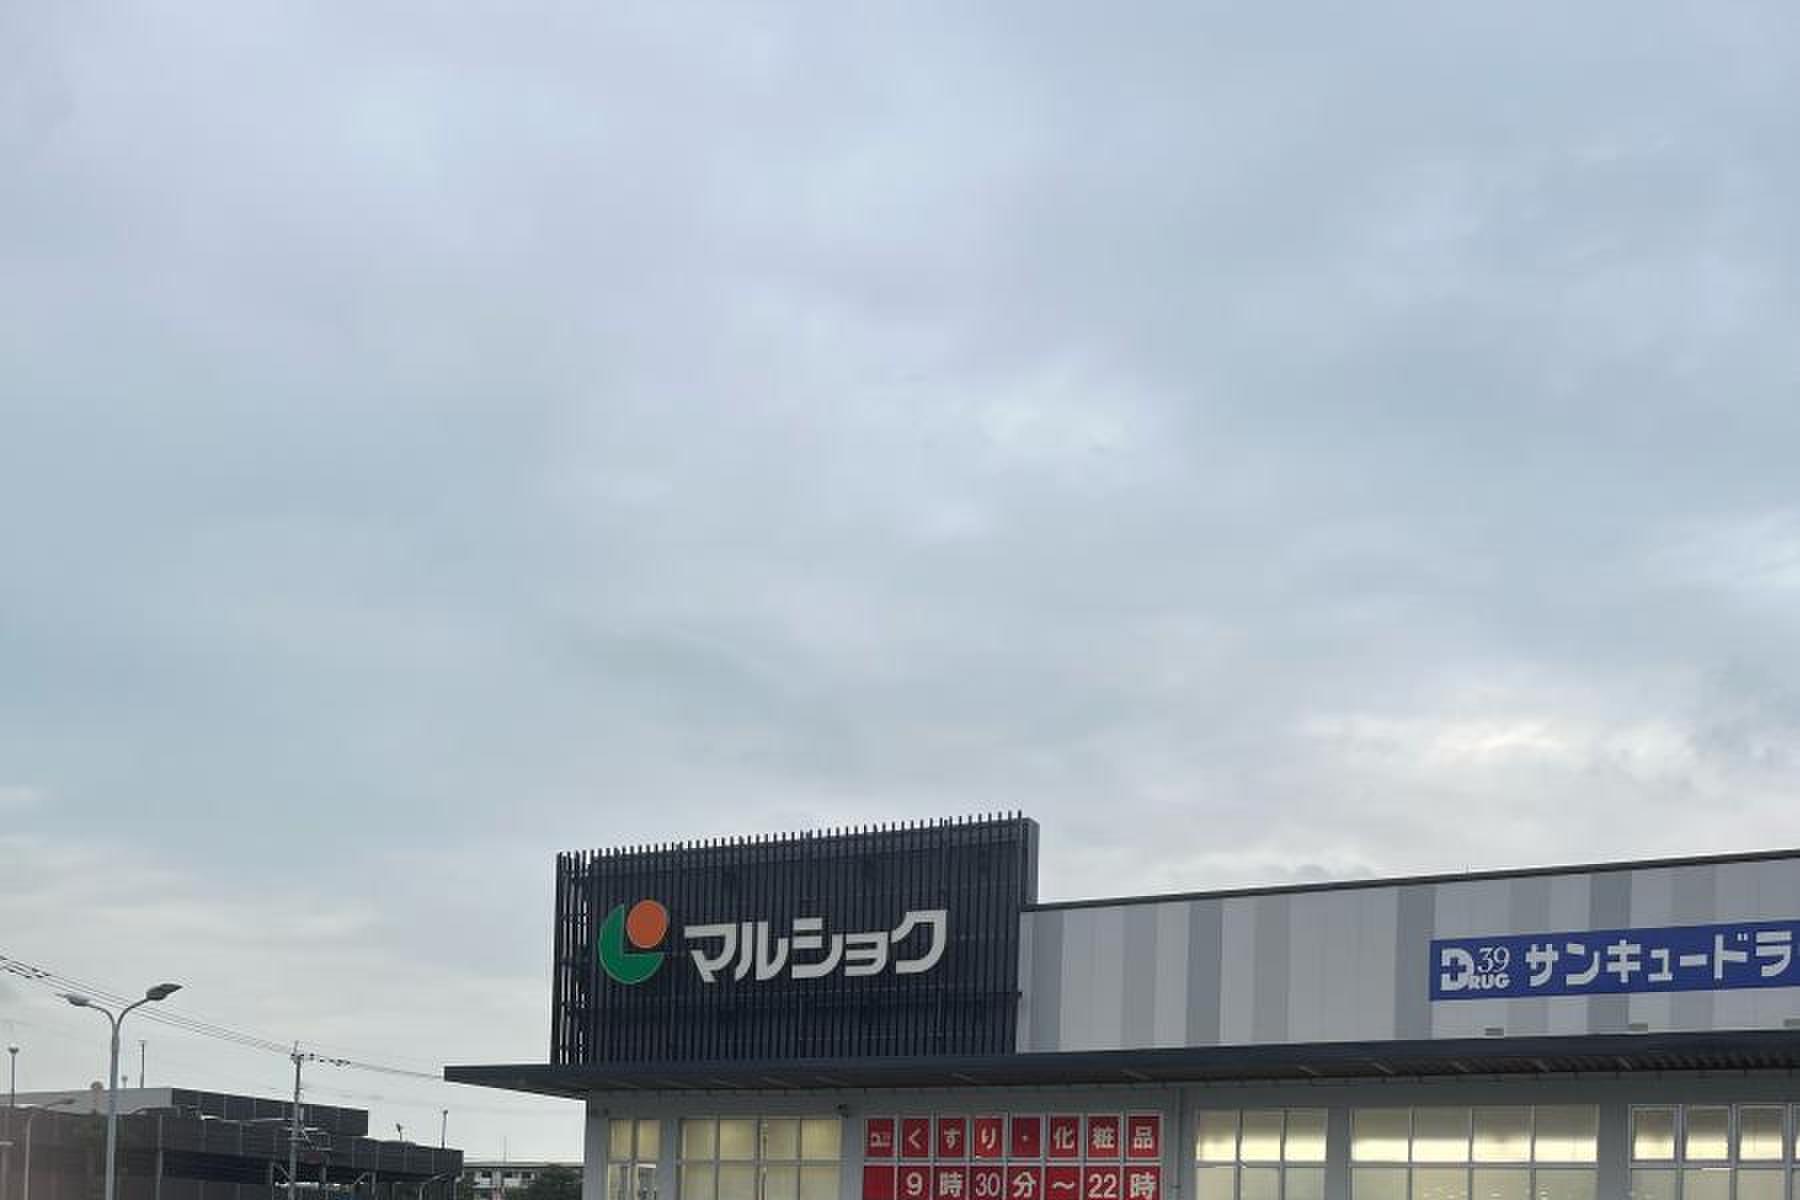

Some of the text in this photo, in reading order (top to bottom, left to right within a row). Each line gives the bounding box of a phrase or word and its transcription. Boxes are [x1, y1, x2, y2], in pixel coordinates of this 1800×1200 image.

[684, 909, 948, 982] マルショク
[1526, 930, 1800, 987] サンキュードラ
